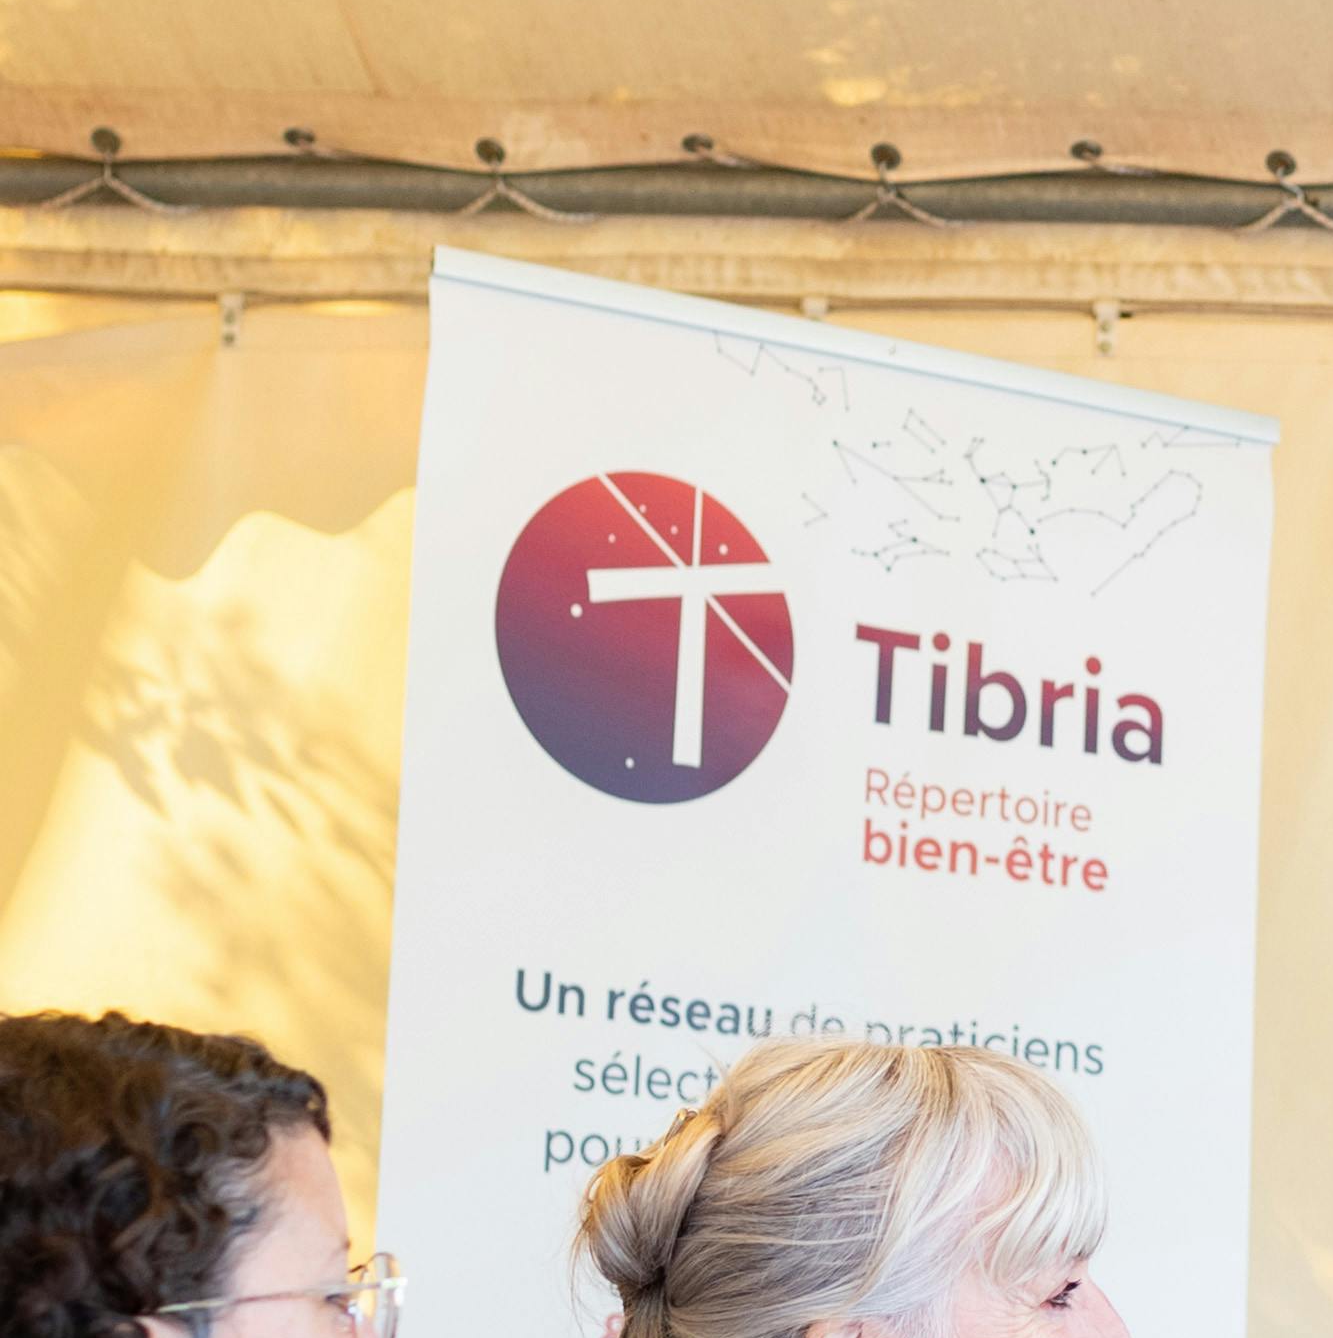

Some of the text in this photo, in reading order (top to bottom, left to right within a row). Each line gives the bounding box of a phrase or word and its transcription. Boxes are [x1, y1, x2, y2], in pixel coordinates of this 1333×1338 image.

[855, 622, 1163, 766] Tibria
[864, 766, 1093, 833] Répertoire
[862, 817, 1109, 892] bien-être
[515, 968, 586, 1017] Un
[606, 979, 773, 1038] réseau
[573, 1051, 731, 1103] sélect
